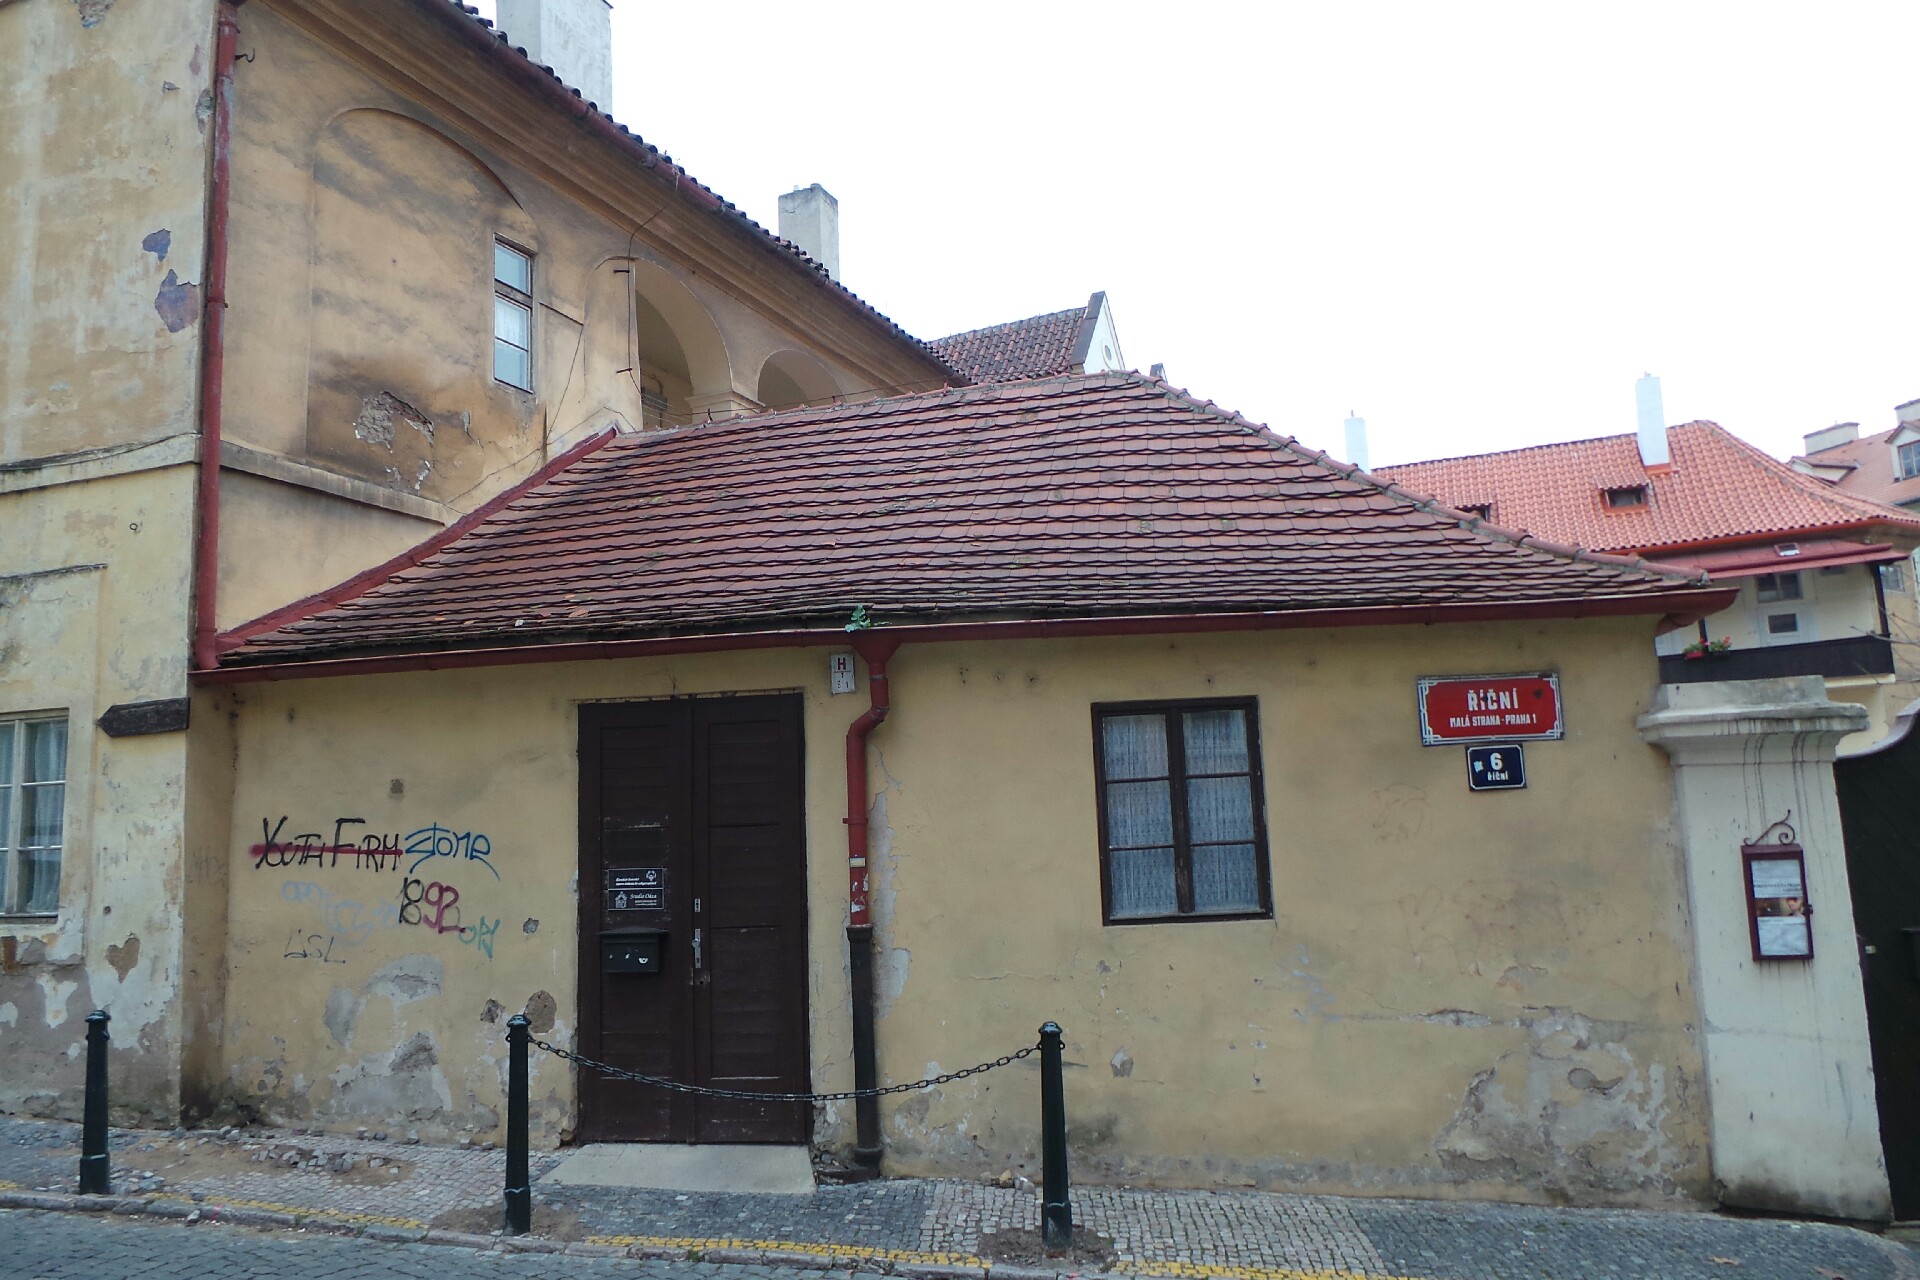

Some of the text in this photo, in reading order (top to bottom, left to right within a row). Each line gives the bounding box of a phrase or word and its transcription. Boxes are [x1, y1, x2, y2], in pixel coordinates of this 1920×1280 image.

[837, 657, 847, 670] H
[1467, 688, 1519, 711] ŘÍČNÍ
[1450, 714, 1470, 728] MALÁ
[1472, 714, 1501, 727] STRANA
[1505, 714, 1531, 726] PRAHA
[1532, 713, 1537, 724] 1
[1490, 752, 1503, 771] 6
